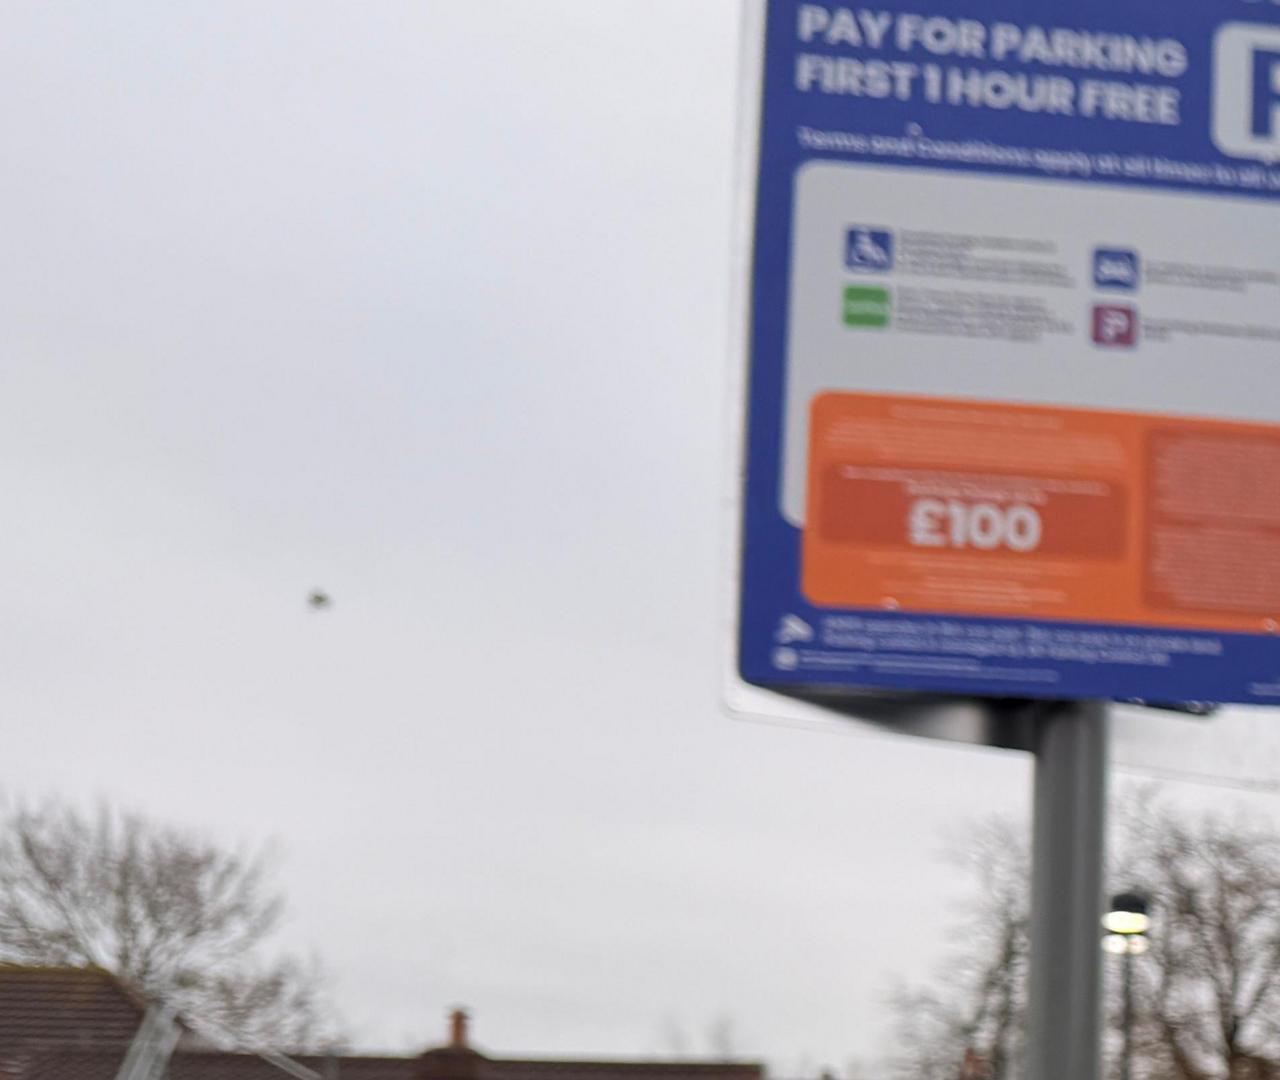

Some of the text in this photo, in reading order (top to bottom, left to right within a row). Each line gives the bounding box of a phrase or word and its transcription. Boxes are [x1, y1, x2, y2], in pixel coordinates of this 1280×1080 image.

[799, 6, 1188, 78] PAY FOR PARKING
[796, 54, 1181, 126] FIRST 1 HOUR FREE
[908, 500, 1042, 550] £100
